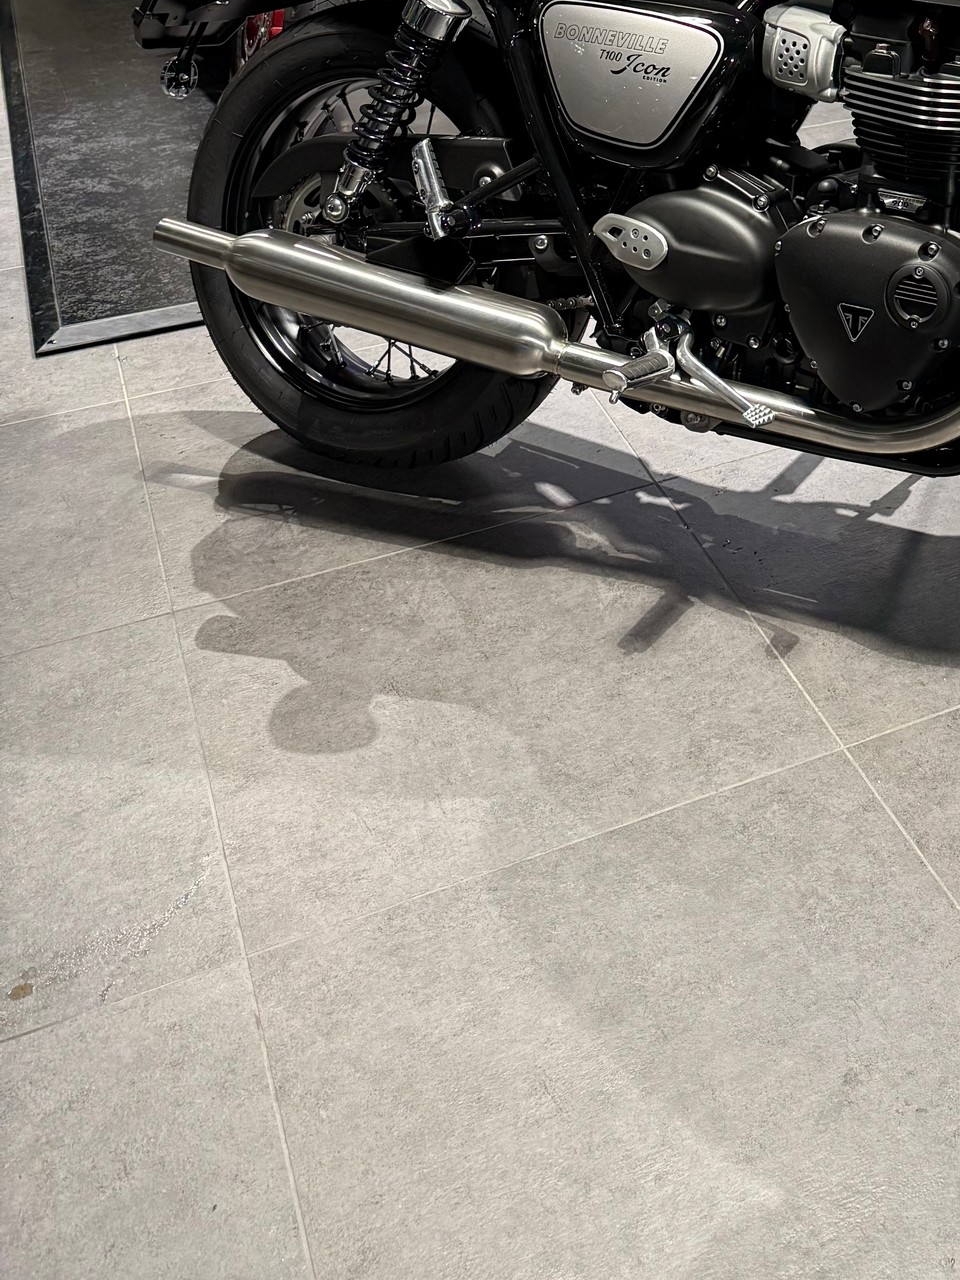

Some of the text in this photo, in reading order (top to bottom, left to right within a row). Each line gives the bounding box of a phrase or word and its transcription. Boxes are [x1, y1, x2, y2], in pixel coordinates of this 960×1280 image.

[554, 23, 669, 55] BONNEVILLE
[599, 49, 671, 78] T100 Icon
[642, 75, 667, 83] EDITION
